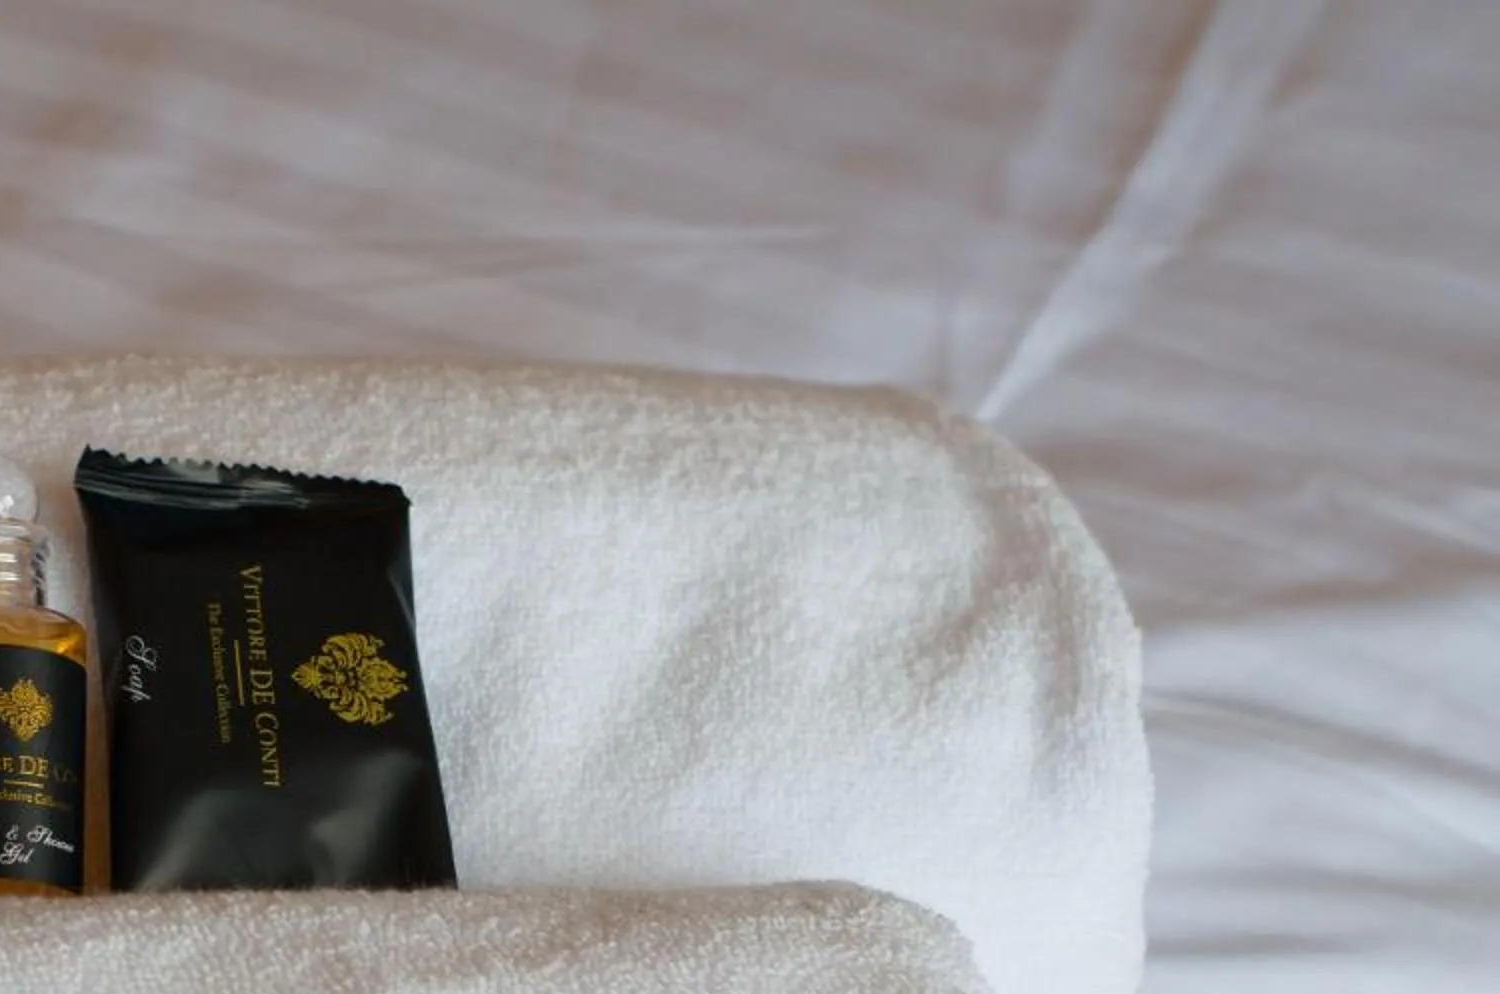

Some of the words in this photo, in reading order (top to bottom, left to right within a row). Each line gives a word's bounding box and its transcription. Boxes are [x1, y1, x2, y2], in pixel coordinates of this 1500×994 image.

[240, 565, 267, 663] VITTORE
[120, 634, 158, 703] Soap
[249, 669, 275, 706] DE
[19, 755, 50, 779] DE
[254, 711, 281, 788] CONTI
[5, 825, 20, 842] &
